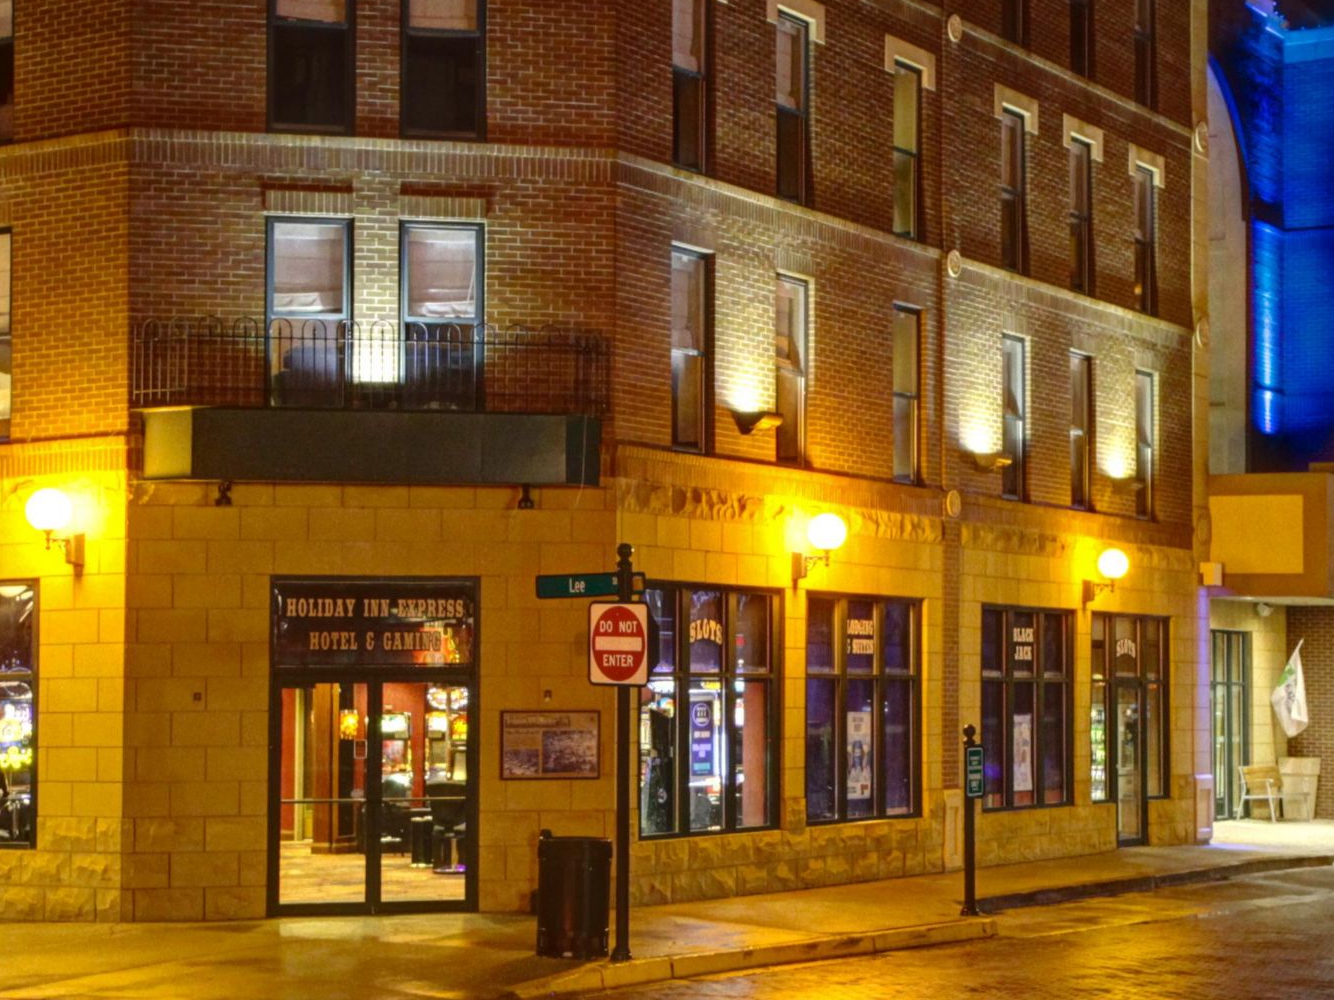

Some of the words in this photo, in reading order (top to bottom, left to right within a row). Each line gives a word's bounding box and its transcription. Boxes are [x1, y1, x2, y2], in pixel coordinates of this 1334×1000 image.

[569, 578, 586, 593] Lee
[286, 598, 356, 618] HOLIDAY
[364, 598, 391, 617] INN
[398, 598, 464, 618] EXPRESS
[599, 620, 613, 633] DO
[619, 621, 638, 633] NOT
[689, 618, 723, 645] SLOTS
[309, 631, 358, 650] HOTEL
[383, 632, 442, 651] GAMING
[1013, 627, 1034, 643] BLACK
[603, 654, 634, 667] ENTER
[1014, 645, 1033, 661] JACK
